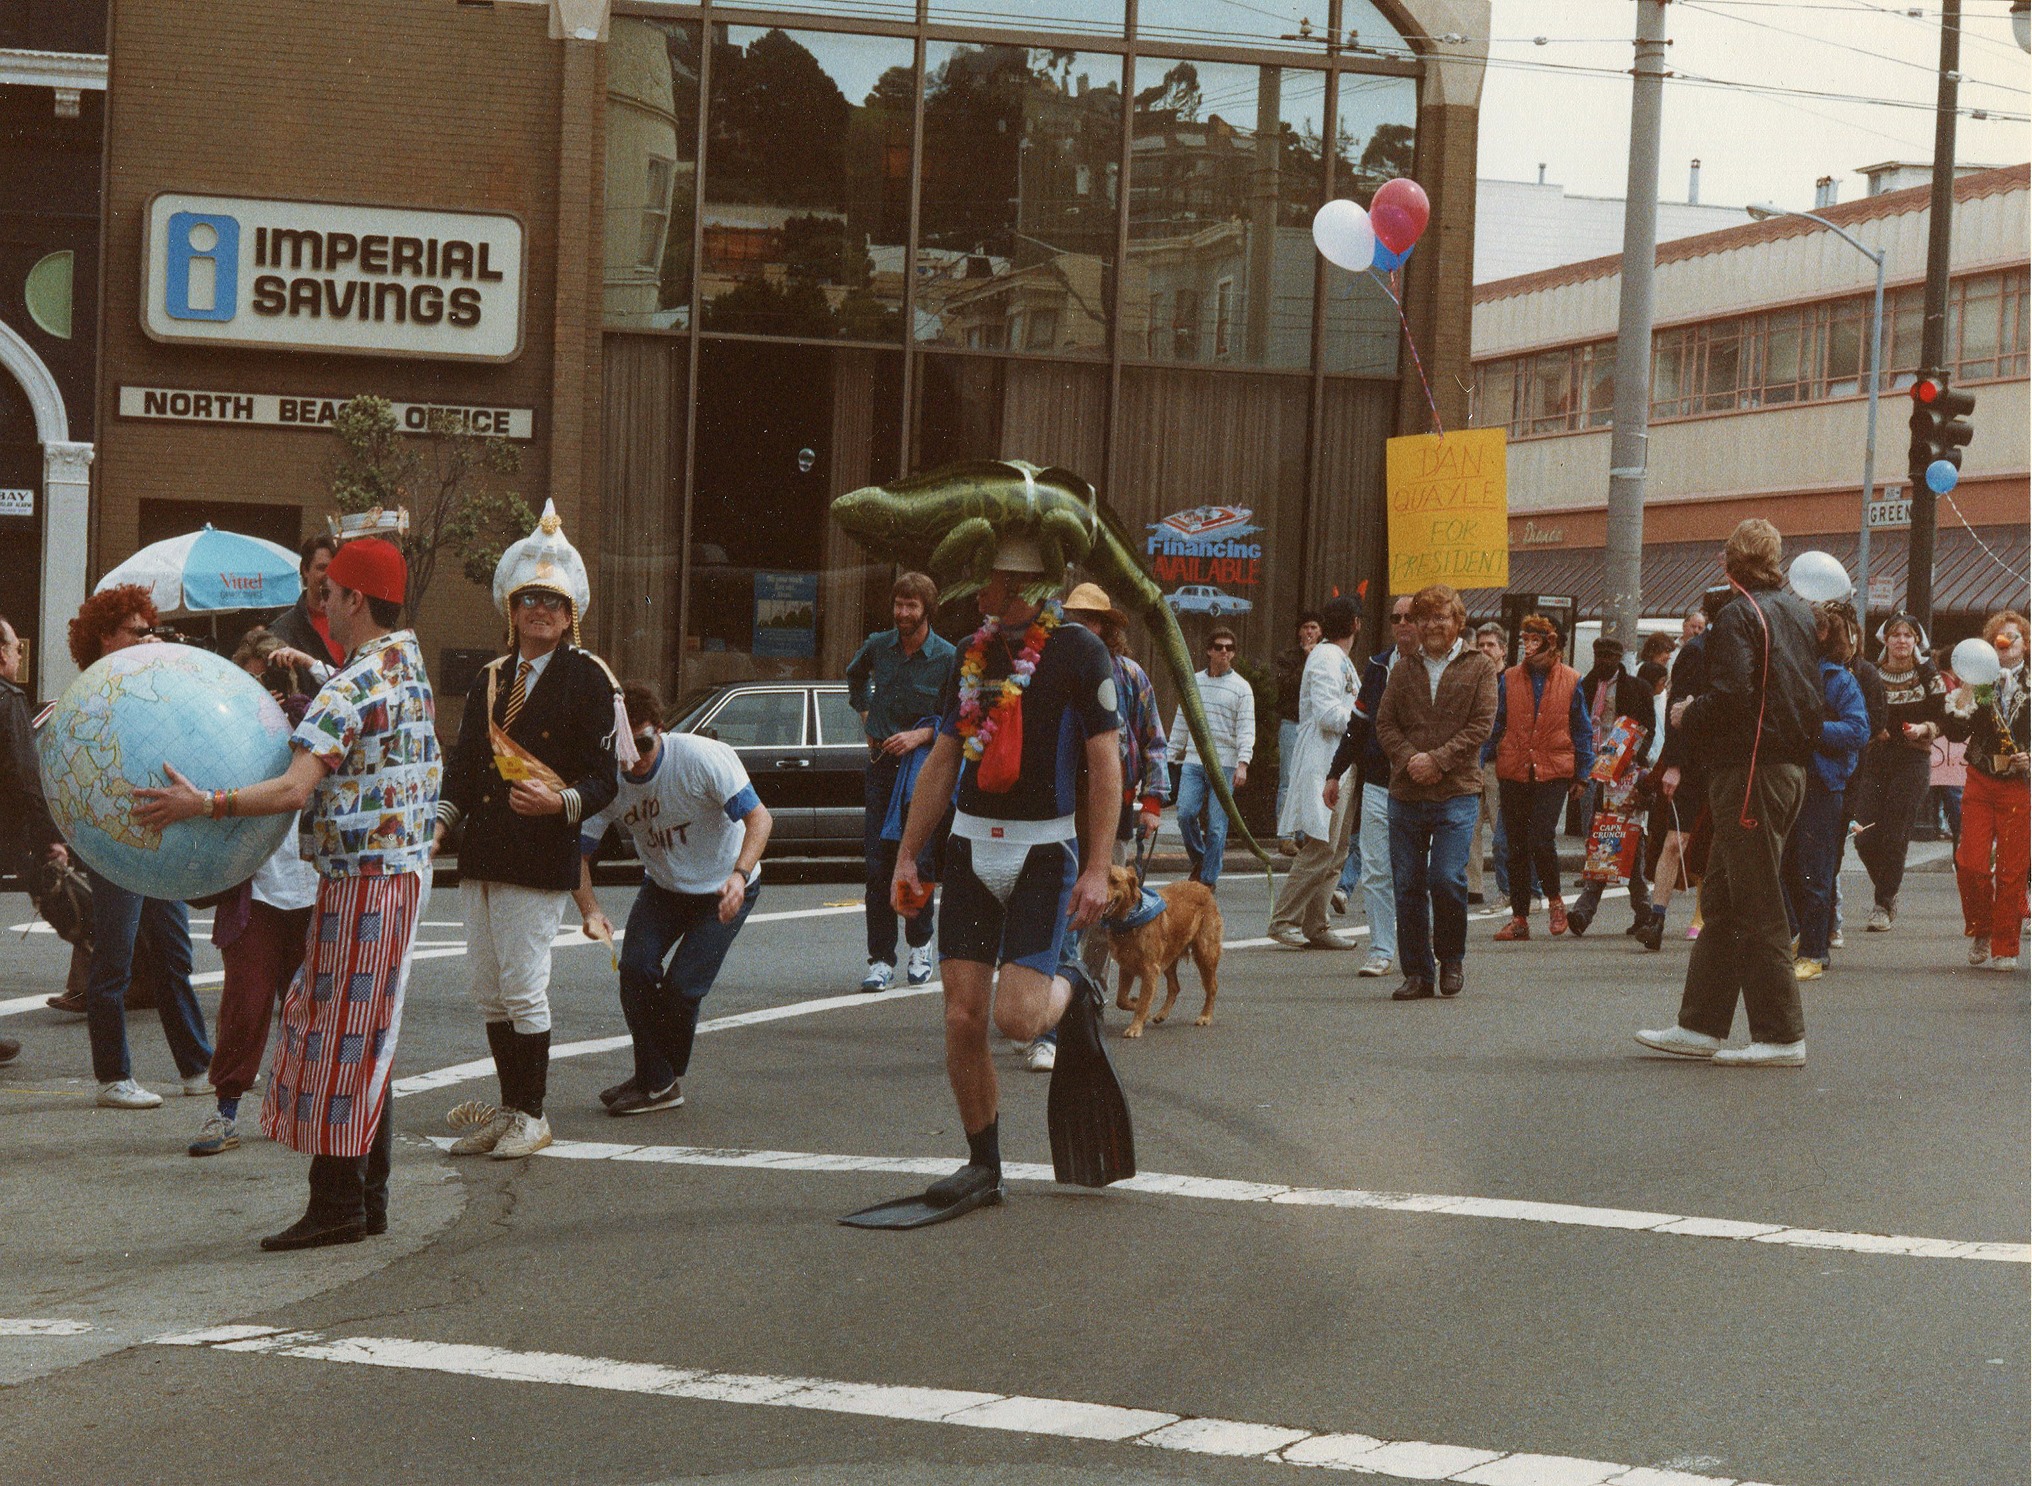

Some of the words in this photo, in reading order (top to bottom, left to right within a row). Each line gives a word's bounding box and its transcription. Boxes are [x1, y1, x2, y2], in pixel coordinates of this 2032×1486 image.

[255, 226, 503, 282] IMPERIAL
[252, 274, 482, 328] SAVINGS
[143, 391, 254, 421] NORTH
[1416, 444, 1484, 477] DAN
[1392, 481, 1498, 512] QUAYLE
[1430, 518, 1478, 546] FOR
[1153, 556, 1261, 584] AVAILABLE
[1392, 549, 1507, 580] PRESIDENT
[219, 571, 263, 590] Vittel
[1592, 831, 1627, 839] CRUNCH
